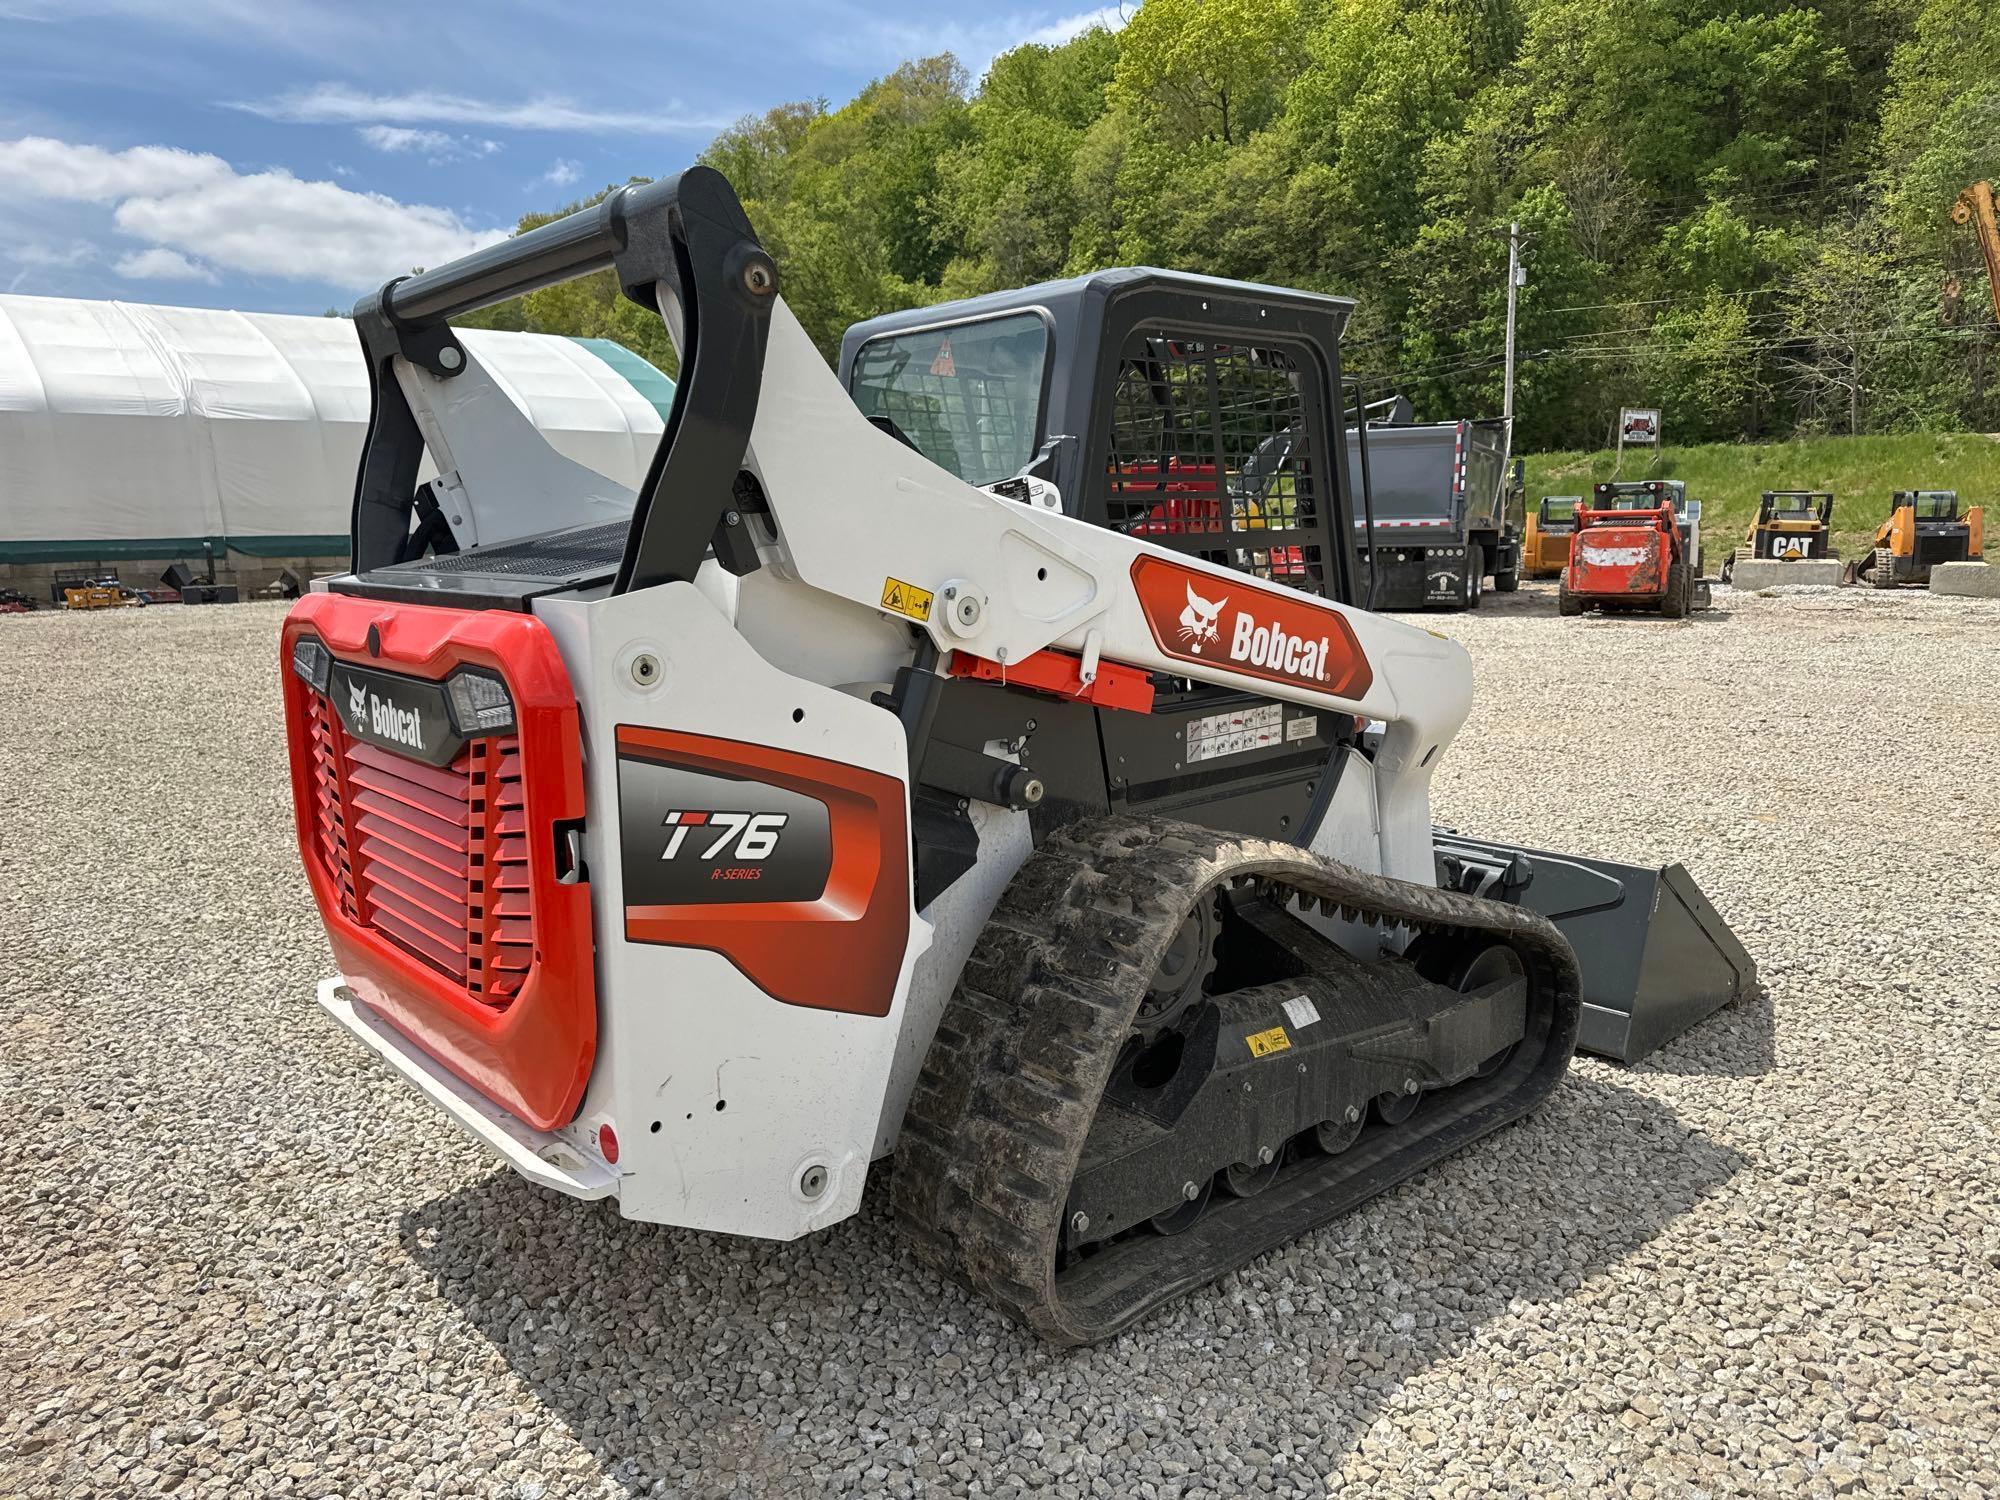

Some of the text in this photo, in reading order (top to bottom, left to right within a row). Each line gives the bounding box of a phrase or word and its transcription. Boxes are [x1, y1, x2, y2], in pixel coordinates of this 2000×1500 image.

[1772, 536, 1813, 558] CAT
[1230, 612, 1329, 681] Bobcat
[370, 693, 423, 750] Bobcat
[660, 811, 788, 860] T76
[711, 868, 763, 880] R-SERIES
